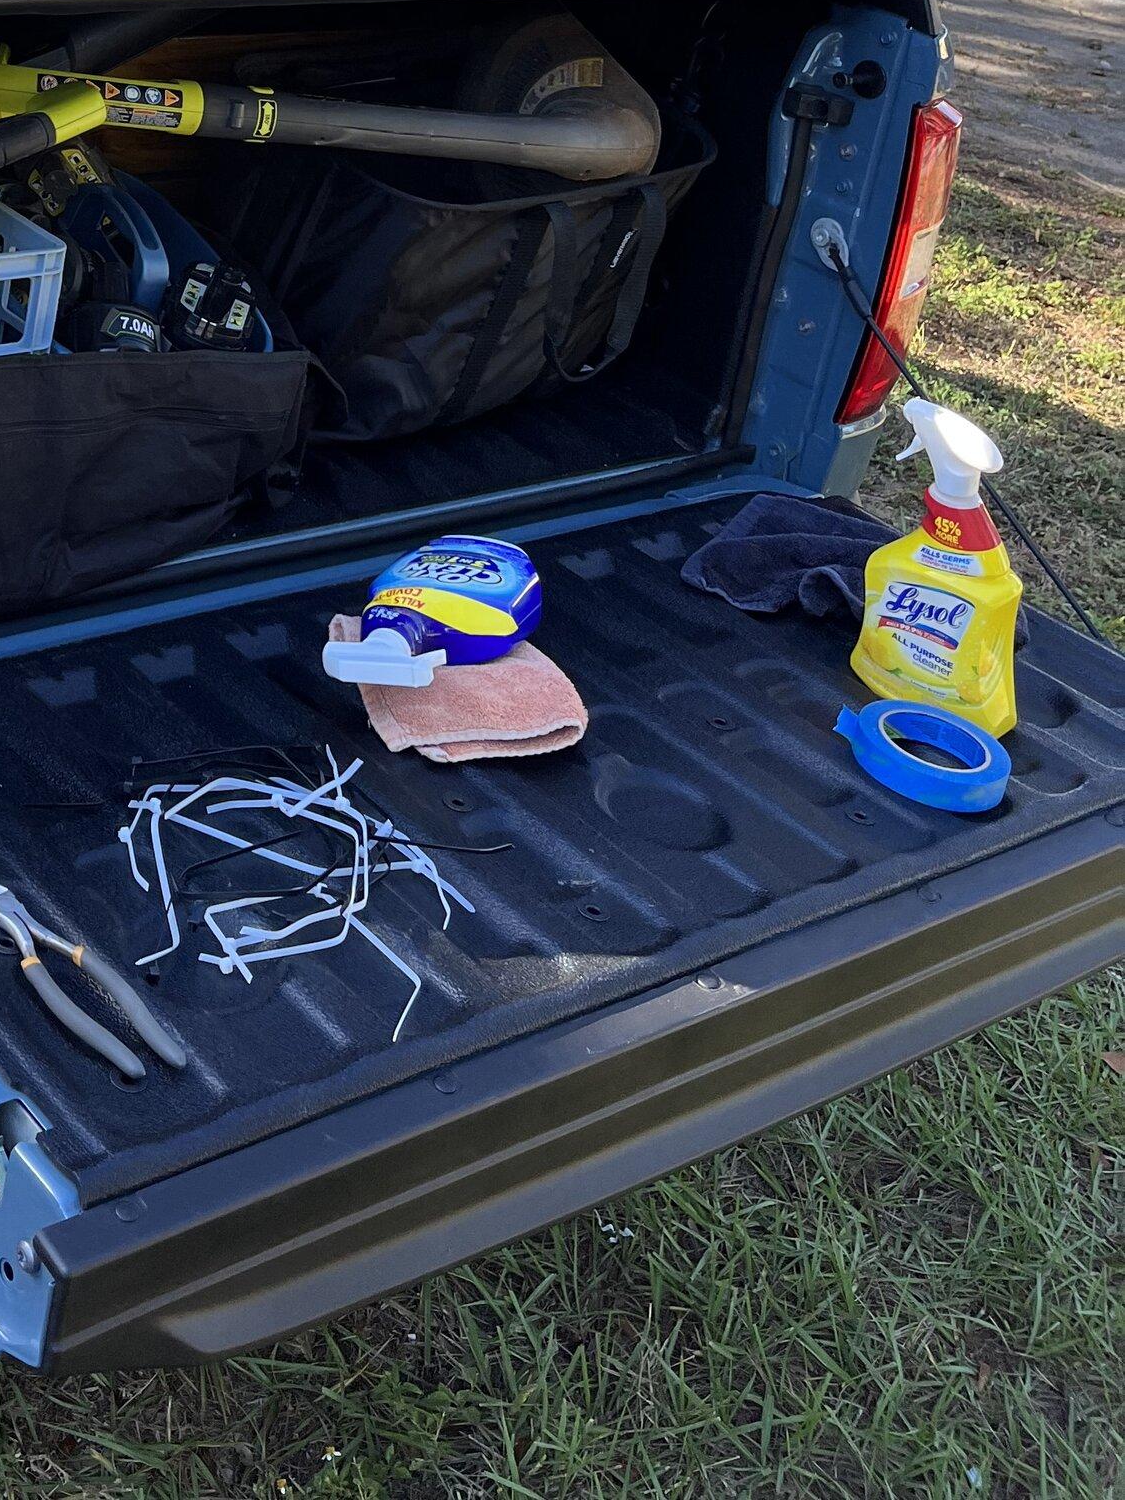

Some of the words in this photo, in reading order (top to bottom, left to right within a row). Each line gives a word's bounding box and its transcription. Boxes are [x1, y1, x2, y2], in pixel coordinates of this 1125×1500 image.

[119, 316, 155, 341] 7.0Ah
[934, 516, 962, 537] 45%
[935, 528, 960, 545] MORE
[920, 547, 941, 559] KILLS
[397, 562, 502, 585] CLEAN
[394, 596, 425, 609] KILLS
[885, 585, 968, 629] Lysol
[891, 632, 909, 647] ALL
[910, 642, 954, 670] PURPOSE
[912, 653, 953, 677] cleaner
